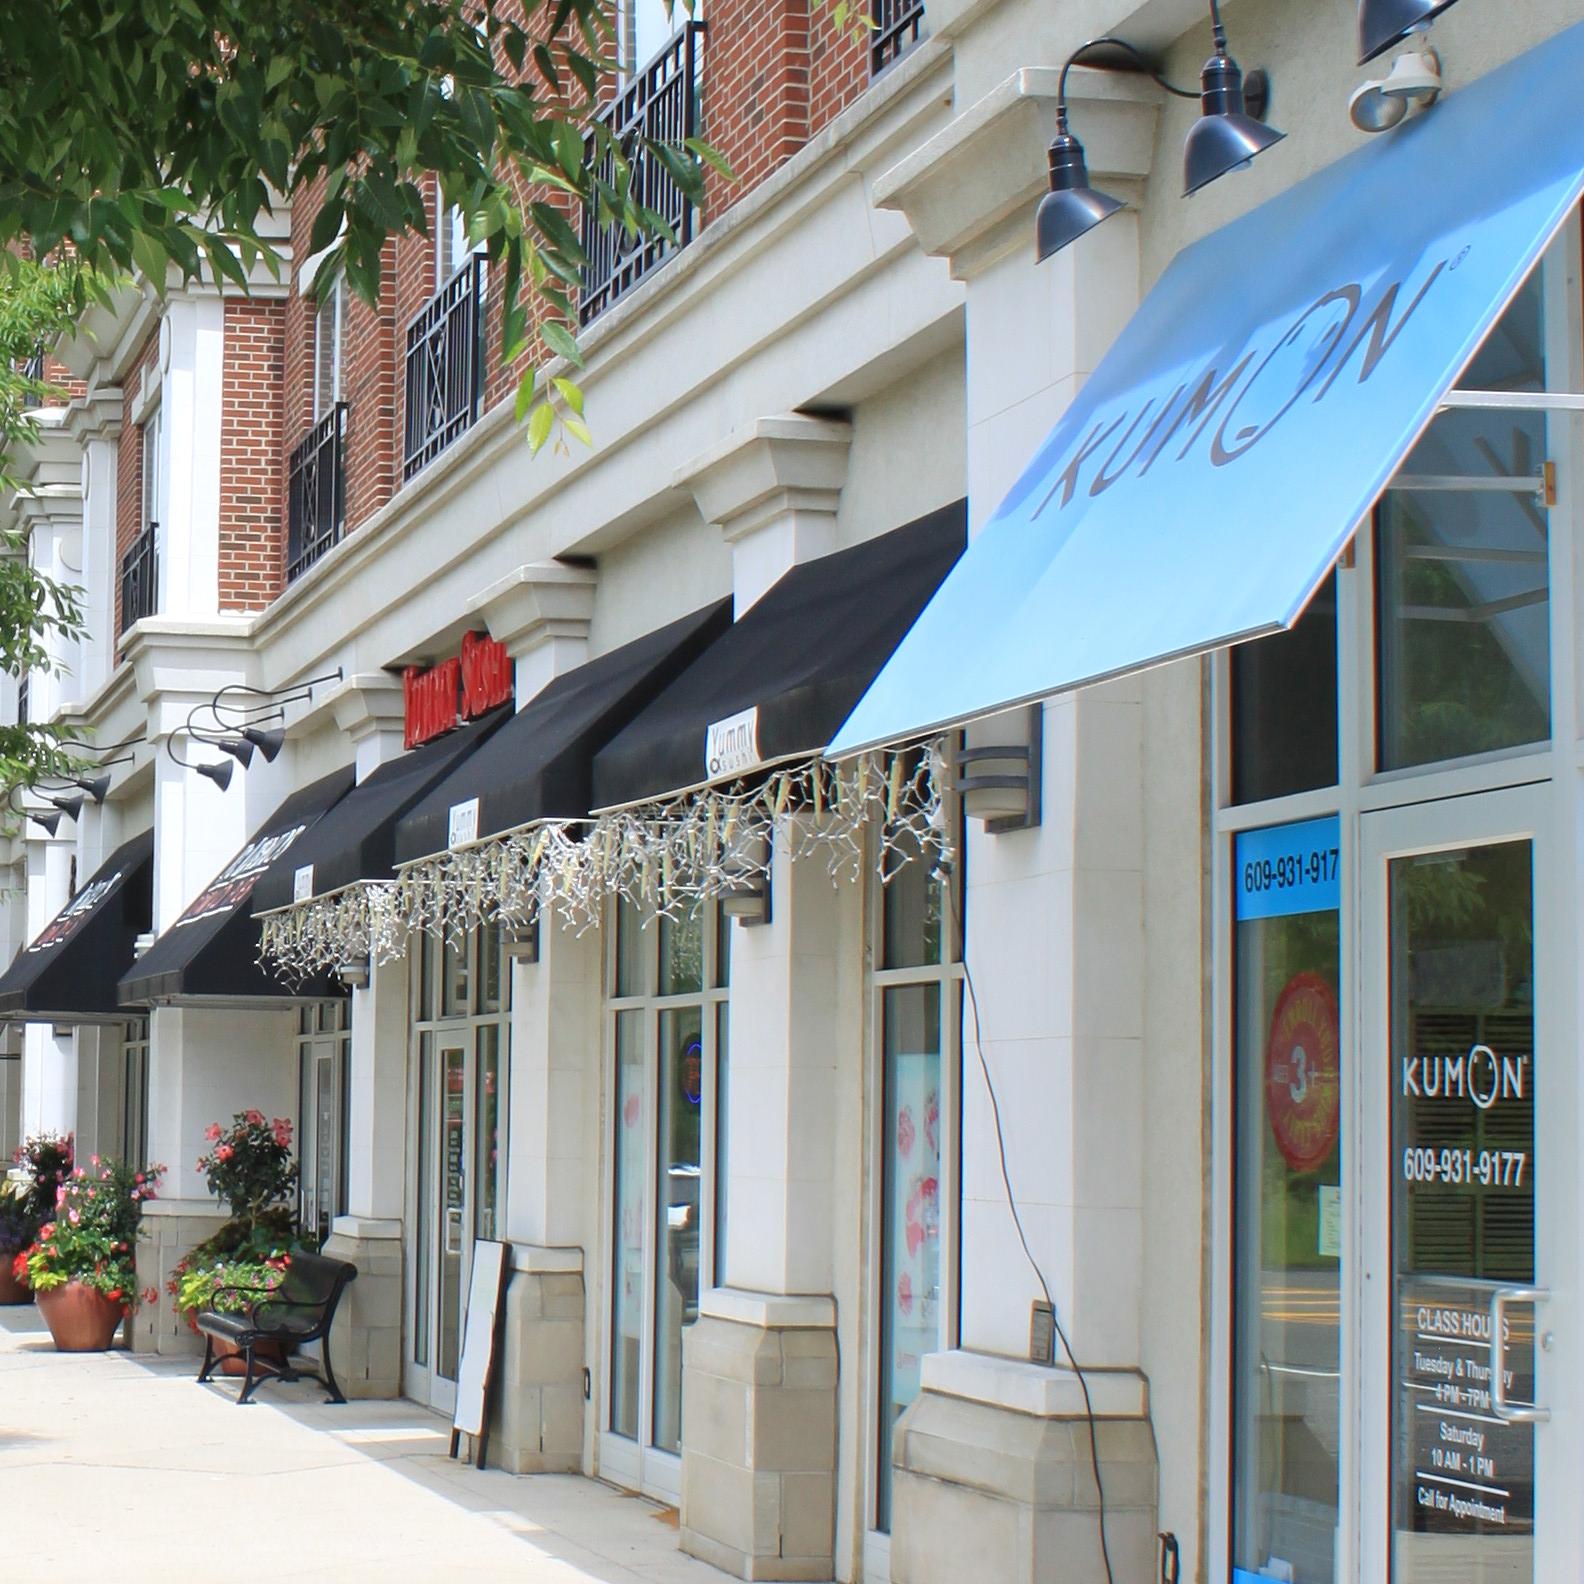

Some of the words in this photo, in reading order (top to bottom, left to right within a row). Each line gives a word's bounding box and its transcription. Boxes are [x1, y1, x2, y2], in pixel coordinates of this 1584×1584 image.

[1031, 259, 1448, 522] KUMON
[1402, 1044, 1523, 1108] KUMON
[1403, 1146, 1526, 1188] 609-931-9177
[1417, 1306, 1460, 1335] CLASS
[1461, 1312, 1511, 1342] HOUS
[1414, 1351, 1453, 1381] Tuesday
[1455, 1357, 1464, 1377] &
[1439, 1420, 1484, 1453] Saturday
[1431, 1447, 1443, 1468] 10
[1443, 1450, 1462, 1472] AM
[1476, 1456, 1495, 1479] PM
[1418, 1486, 1435, 1508] Call
[1435, 1490, 1448, 1510] for
[1448, 1493, 1506, 1525] Appointment
